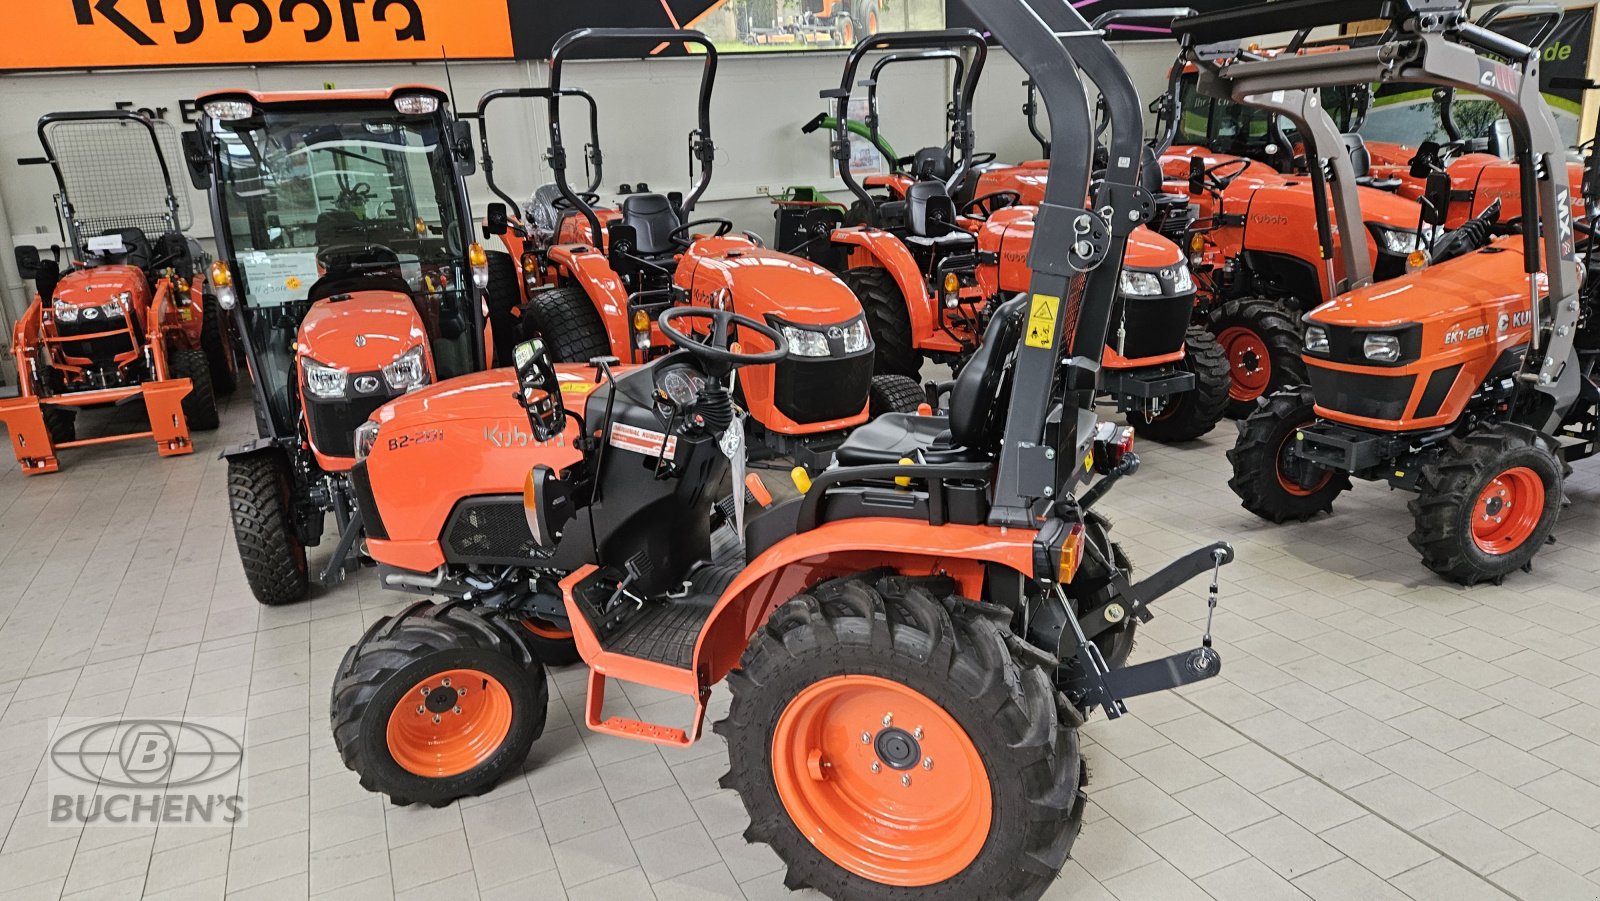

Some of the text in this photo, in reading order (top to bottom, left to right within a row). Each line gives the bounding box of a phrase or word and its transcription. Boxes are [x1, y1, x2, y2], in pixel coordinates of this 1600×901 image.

[73, 0, 426, 46] Kubota
[1480, 71, 1496, 87] C1
[1250, 213, 1288, 225] Kubota
[1557, 188, 1571, 241] MX
[1004, 250, 1029, 264] Kubo
[1444, 324, 1490, 345] EK1-261
